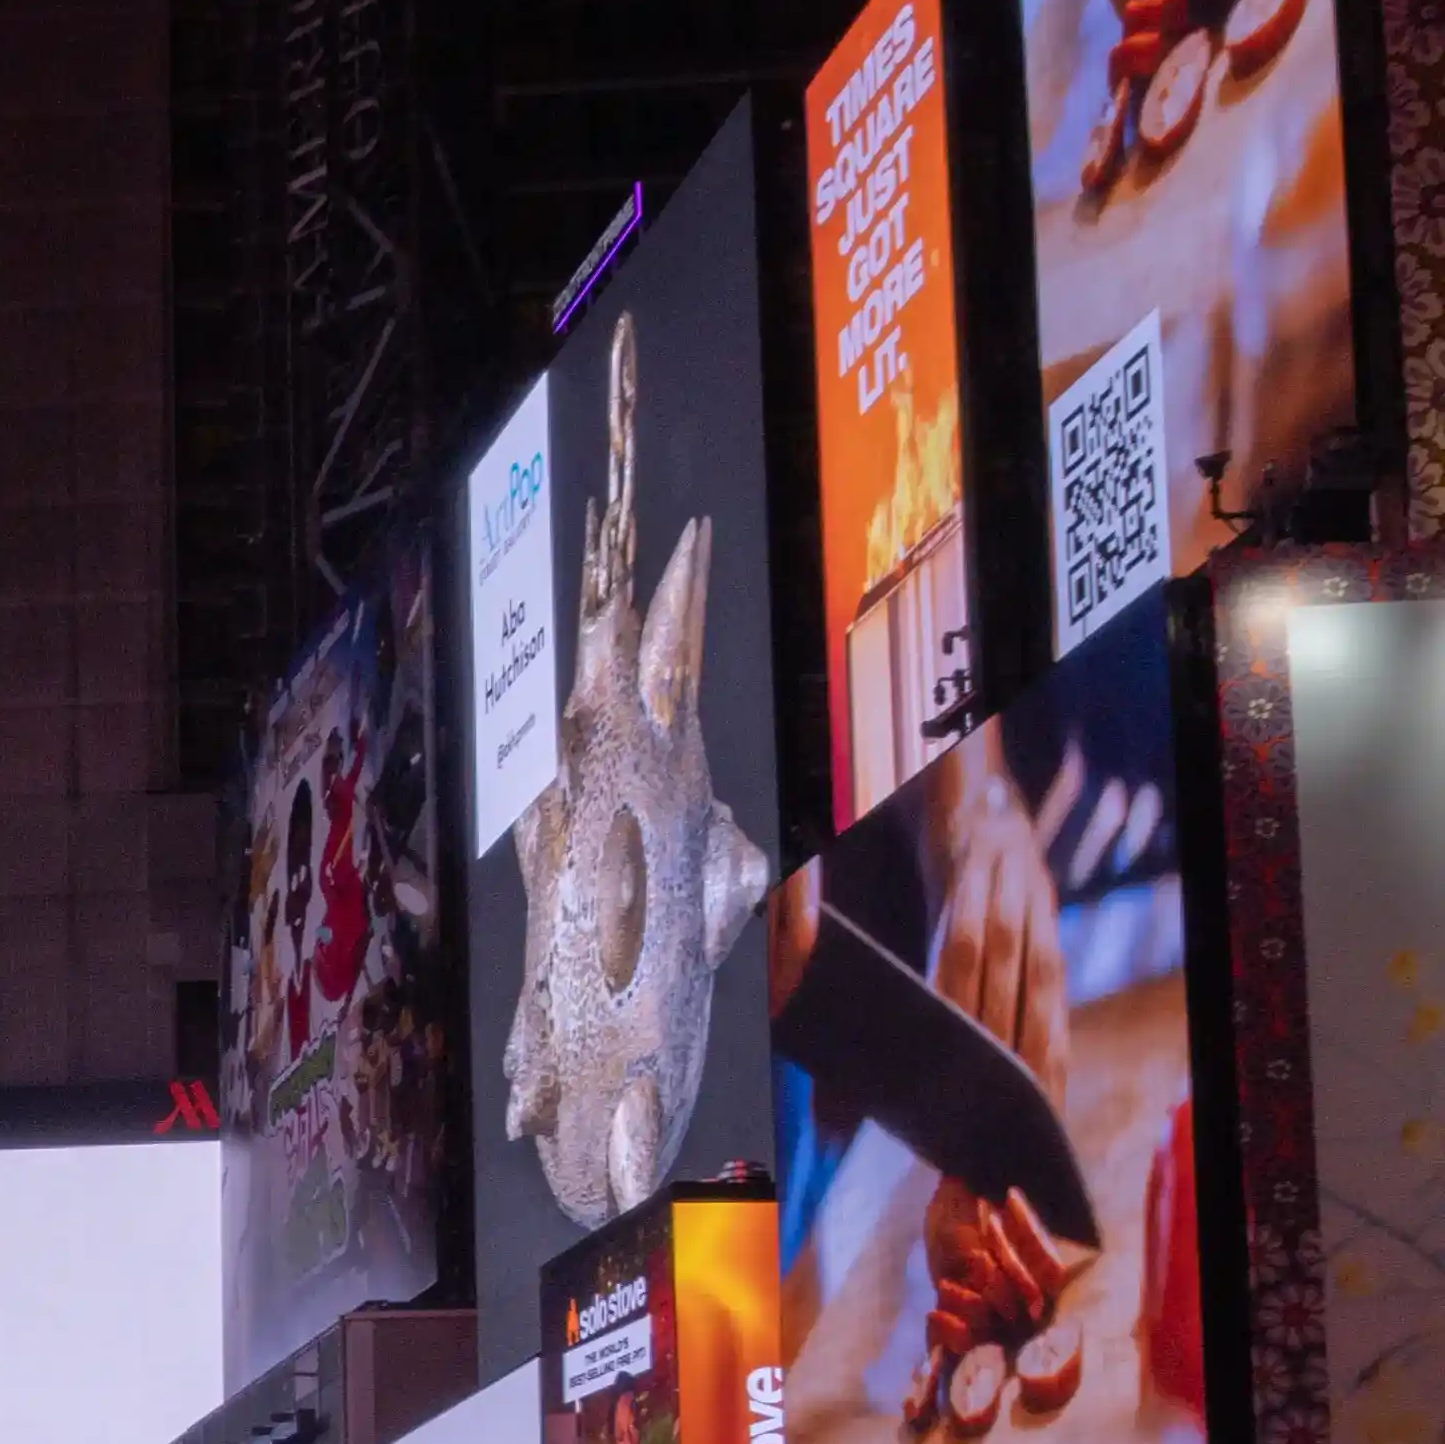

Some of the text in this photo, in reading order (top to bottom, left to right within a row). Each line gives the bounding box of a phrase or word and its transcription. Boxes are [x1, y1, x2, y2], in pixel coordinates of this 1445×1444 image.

[816, 36, 936, 225] SQUARE
[826, 2, 916, 146] TIMES
[838, 125, 914, 256] JUST
[847, 192, 909, 303] GOT
[837, 236, 925, 378] MORE
[857, 324, 907, 416] LIT.
[484, 625, 546, 714] Hutchison
[501, 598, 526, 649] Aba
